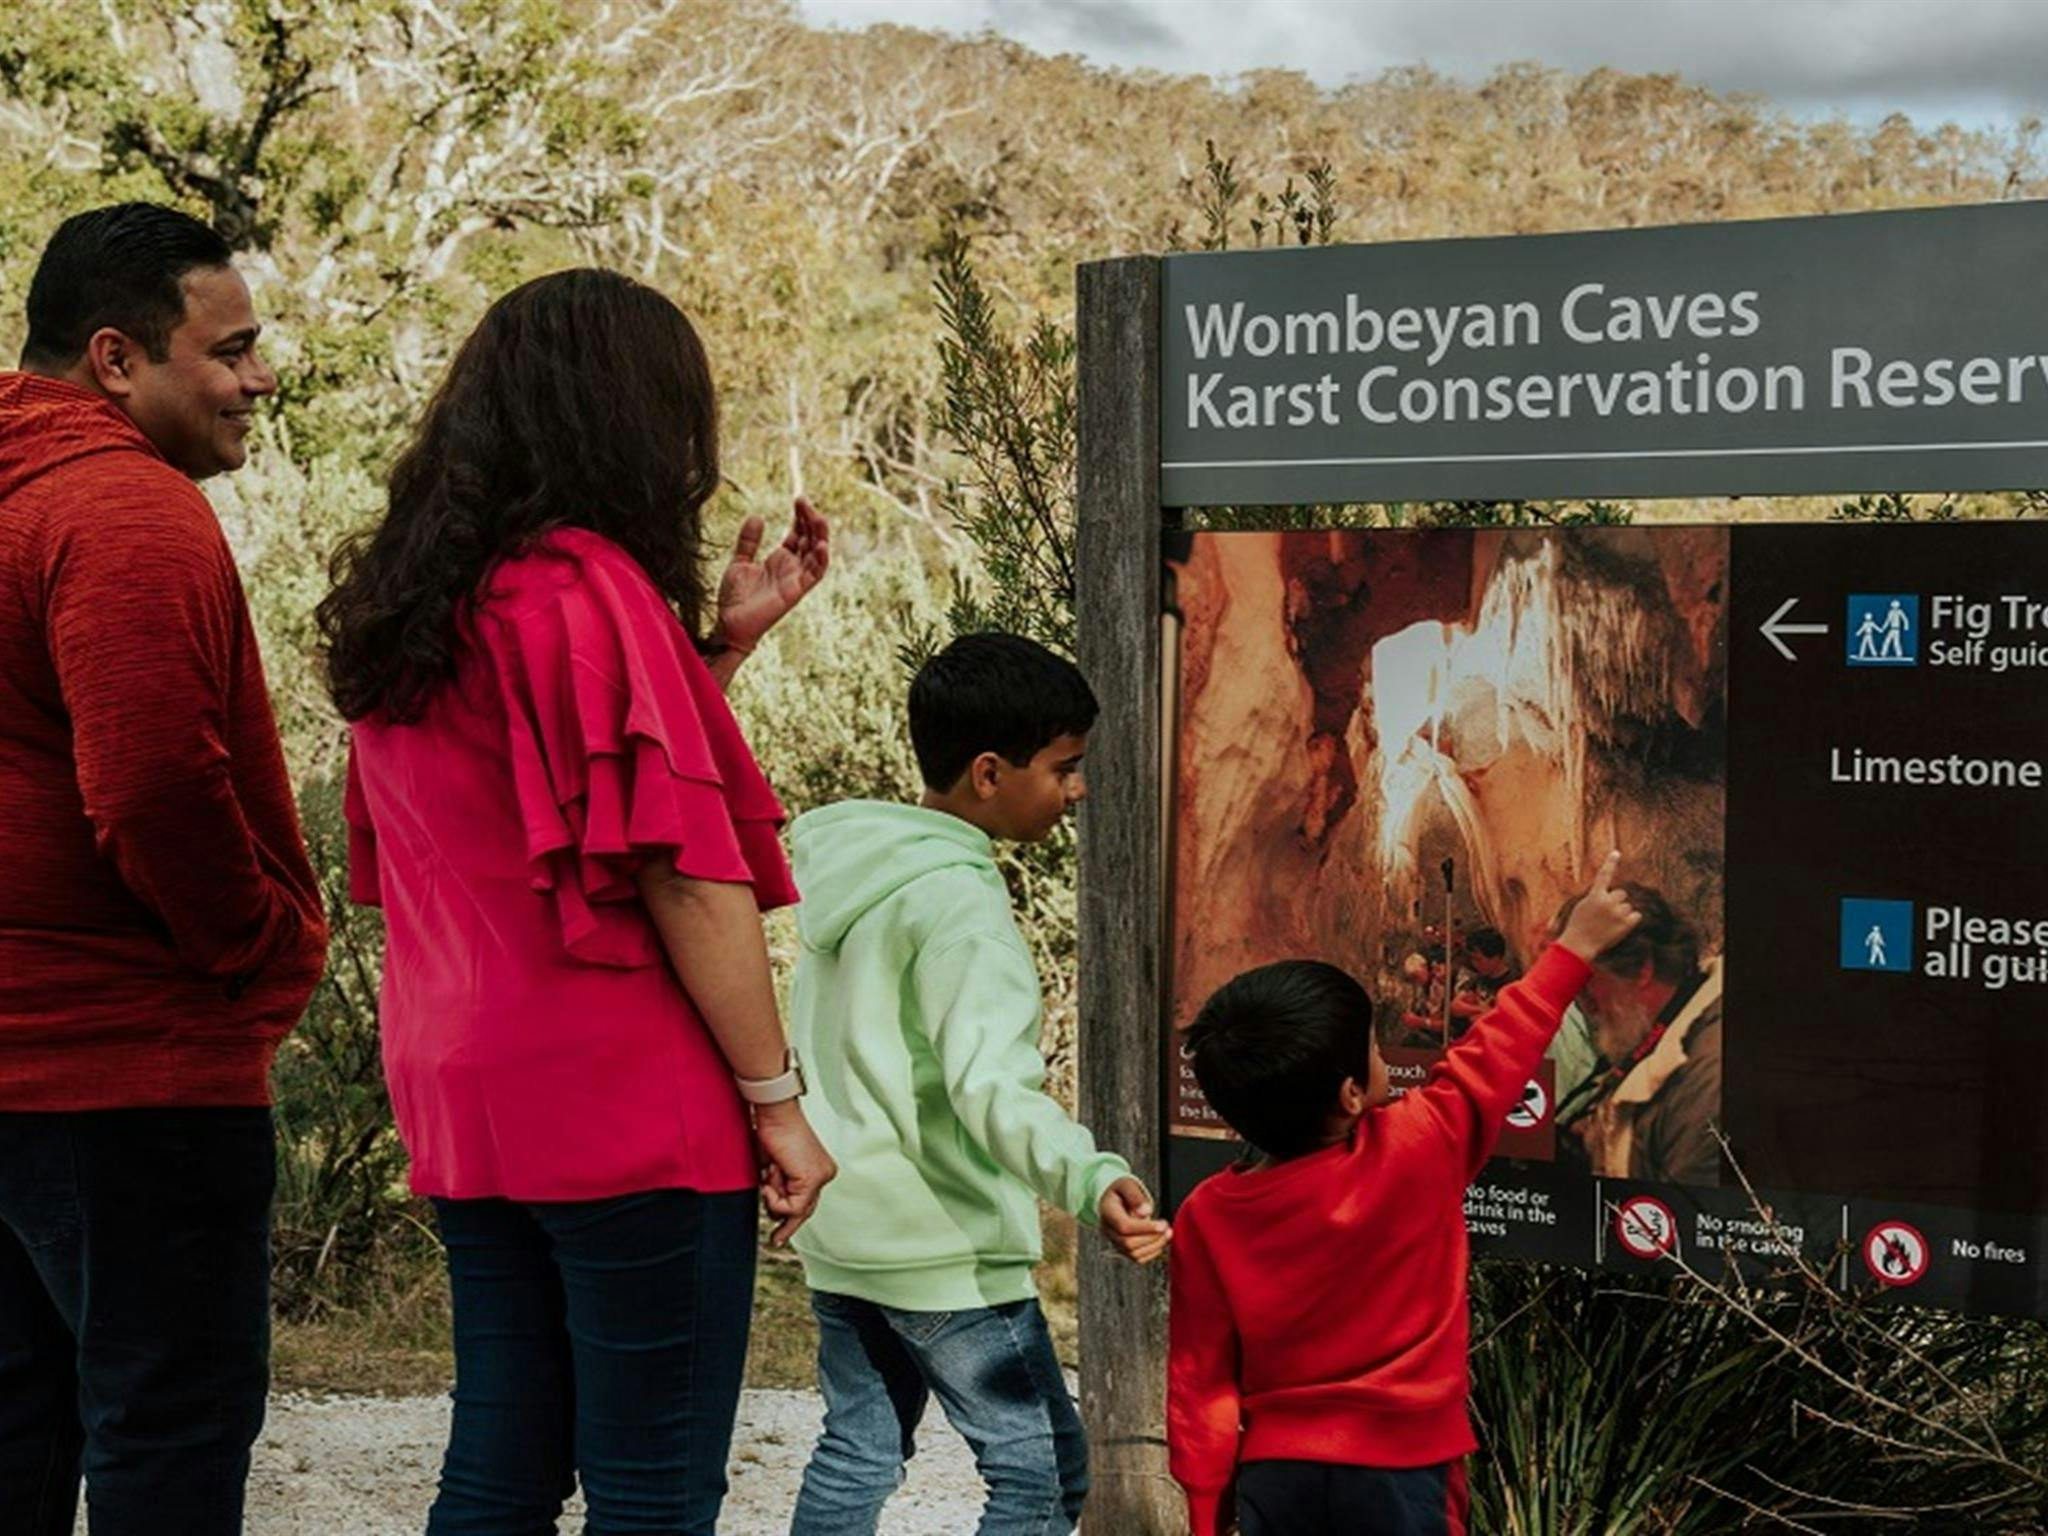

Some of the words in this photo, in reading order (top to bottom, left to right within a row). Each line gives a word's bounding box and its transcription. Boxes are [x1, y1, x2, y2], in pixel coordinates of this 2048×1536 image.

[1185, 294, 1539, 366] Wombeyan
[1561, 283, 1759, 343] Caves
[1188, 373, 1340, 428] Karst
[1357, 353, 1804, 423] Conservation
[1831, 347, 2048, 407] Reser
[1932, 595, 1991, 638] Fig
[1929, 640, 1985, 665] Self
[1830, 749, 2042, 786] Limestone
[1926, 906, 2048, 947] Please
[1924, 942, 1970, 978] all
[1983, 949, 2048, 989] gui
[1488, 1185, 1528, 1204] food
[1530, 1193, 1549, 1206] or
[1462, 1201, 1505, 1219] drink
[1507, 1204, 1524, 1220] in
[1527, 1207, 1556, 1225] the
[1696, 1213, 1723, 1231] No
[1726, 1220, 1804, 1242] smong
[1696, 1231, 1714, 1248] in
[1718, 1234, 1748, 1252] te
[1952, 1239, 1980, 1258] No
[1984, 1241, 2026, 1263] fires
